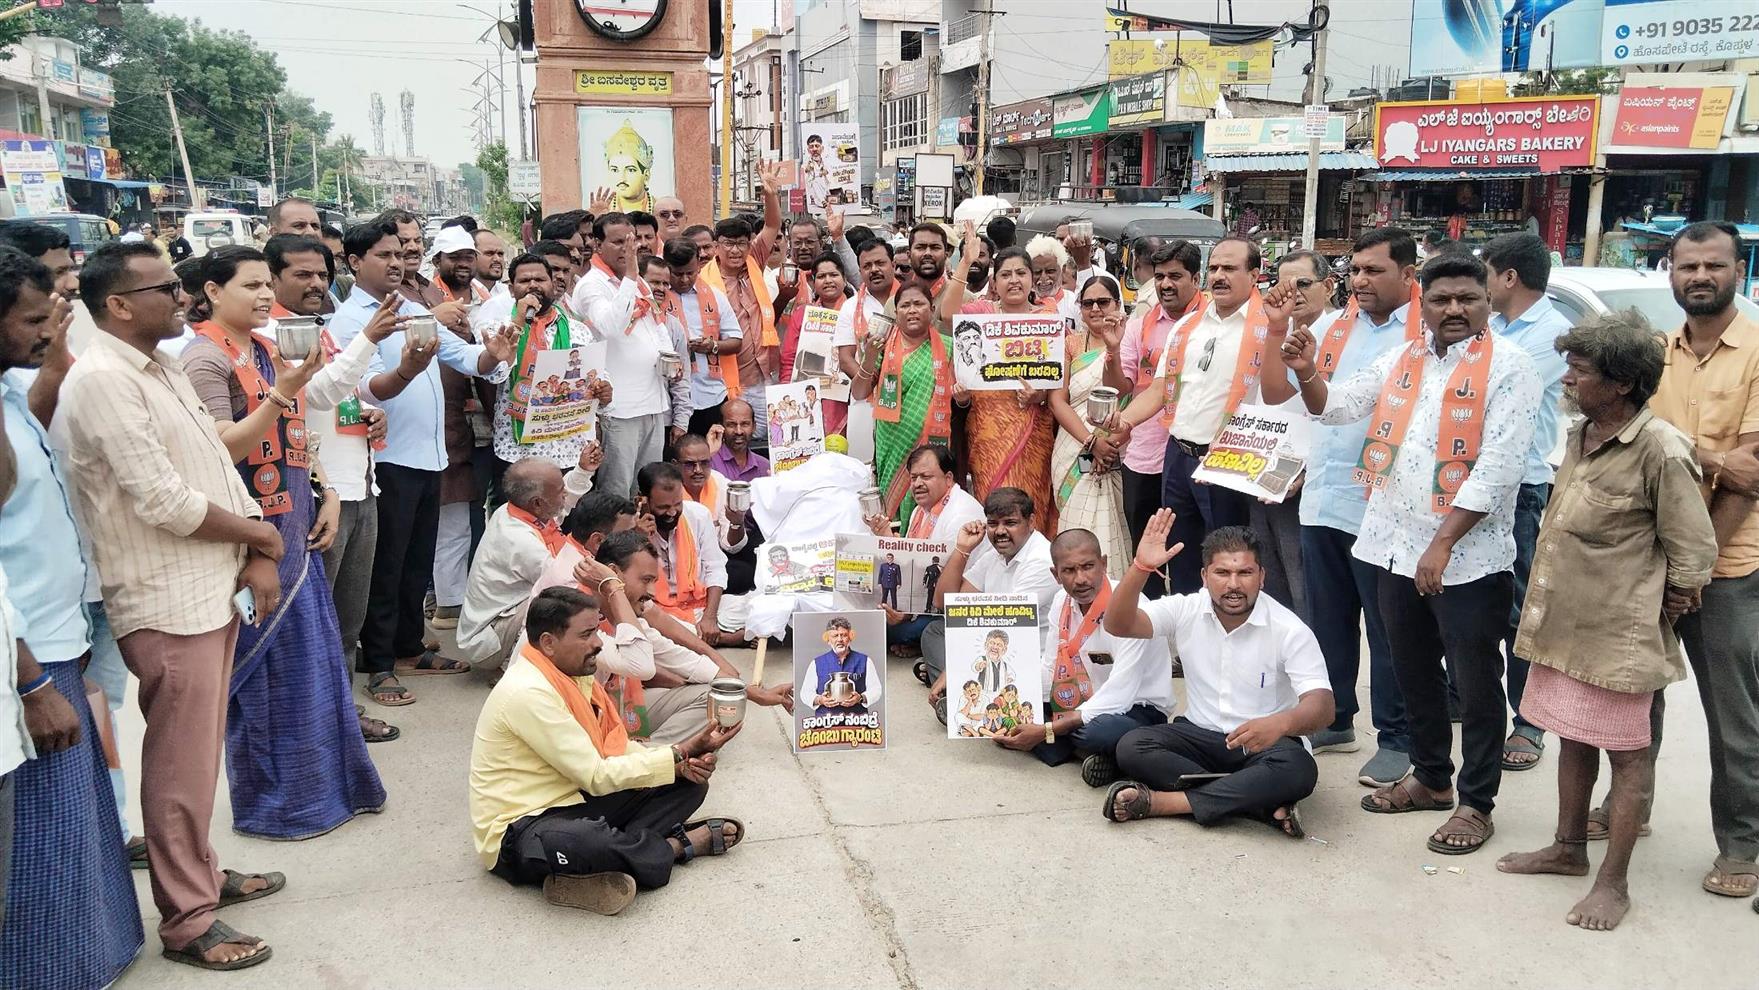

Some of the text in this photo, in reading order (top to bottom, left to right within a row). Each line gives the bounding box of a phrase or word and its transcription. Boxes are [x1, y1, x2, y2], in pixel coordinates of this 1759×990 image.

[1635, 22, 1667, 38] +91
[1672, 17, 1723, 37] 9035
[580, 73, 668, 91] ಶ್ರೀ ಬಸವೇಶ್ವರ ವೃತ್ತ
[1421, 136, 1585, 153] LJ IYANGARS BAKERY
[1450, 154, 1538, 164] CAKE & SWEETS
[986, 321, 1062, 337] ಡಿಕೆ ಶಿವಕುಮಾರ್
[1005, 340, 1045, 361] ಬಿಟ್ಟಿ
[1028, 365, 1060, 379] ಬರವಿಲ್ಲ
[1255, 418, 1289, 434] ಸರ್ಕಾರದ
[1219, 431, 1279, 456] ಖಜಾನೆಯಲ್ಲಿ
[1203, 449, 1268, 482] ಹಣವಿಲ್ಲ
[878, 539, 947, 553] Reality check
[948, 606, 968, 617] ಜನರ
[969, 606, 982, 617] ಕಿವಿ
[983, 605, 1004, 617] ಮೇಲೆ
[966, 617, 1017, 627] ಡಿಕೆ ಶಿವಕುಮಾರ್
[803, 711, 879, 729] ಕಾಂಗ್ರೆಸ್ ನಂಬಿದ್ರೆ
[799, 728, 882, 749] ಚೊಂಬು ಗ್ಯಾರಂಟಿ
